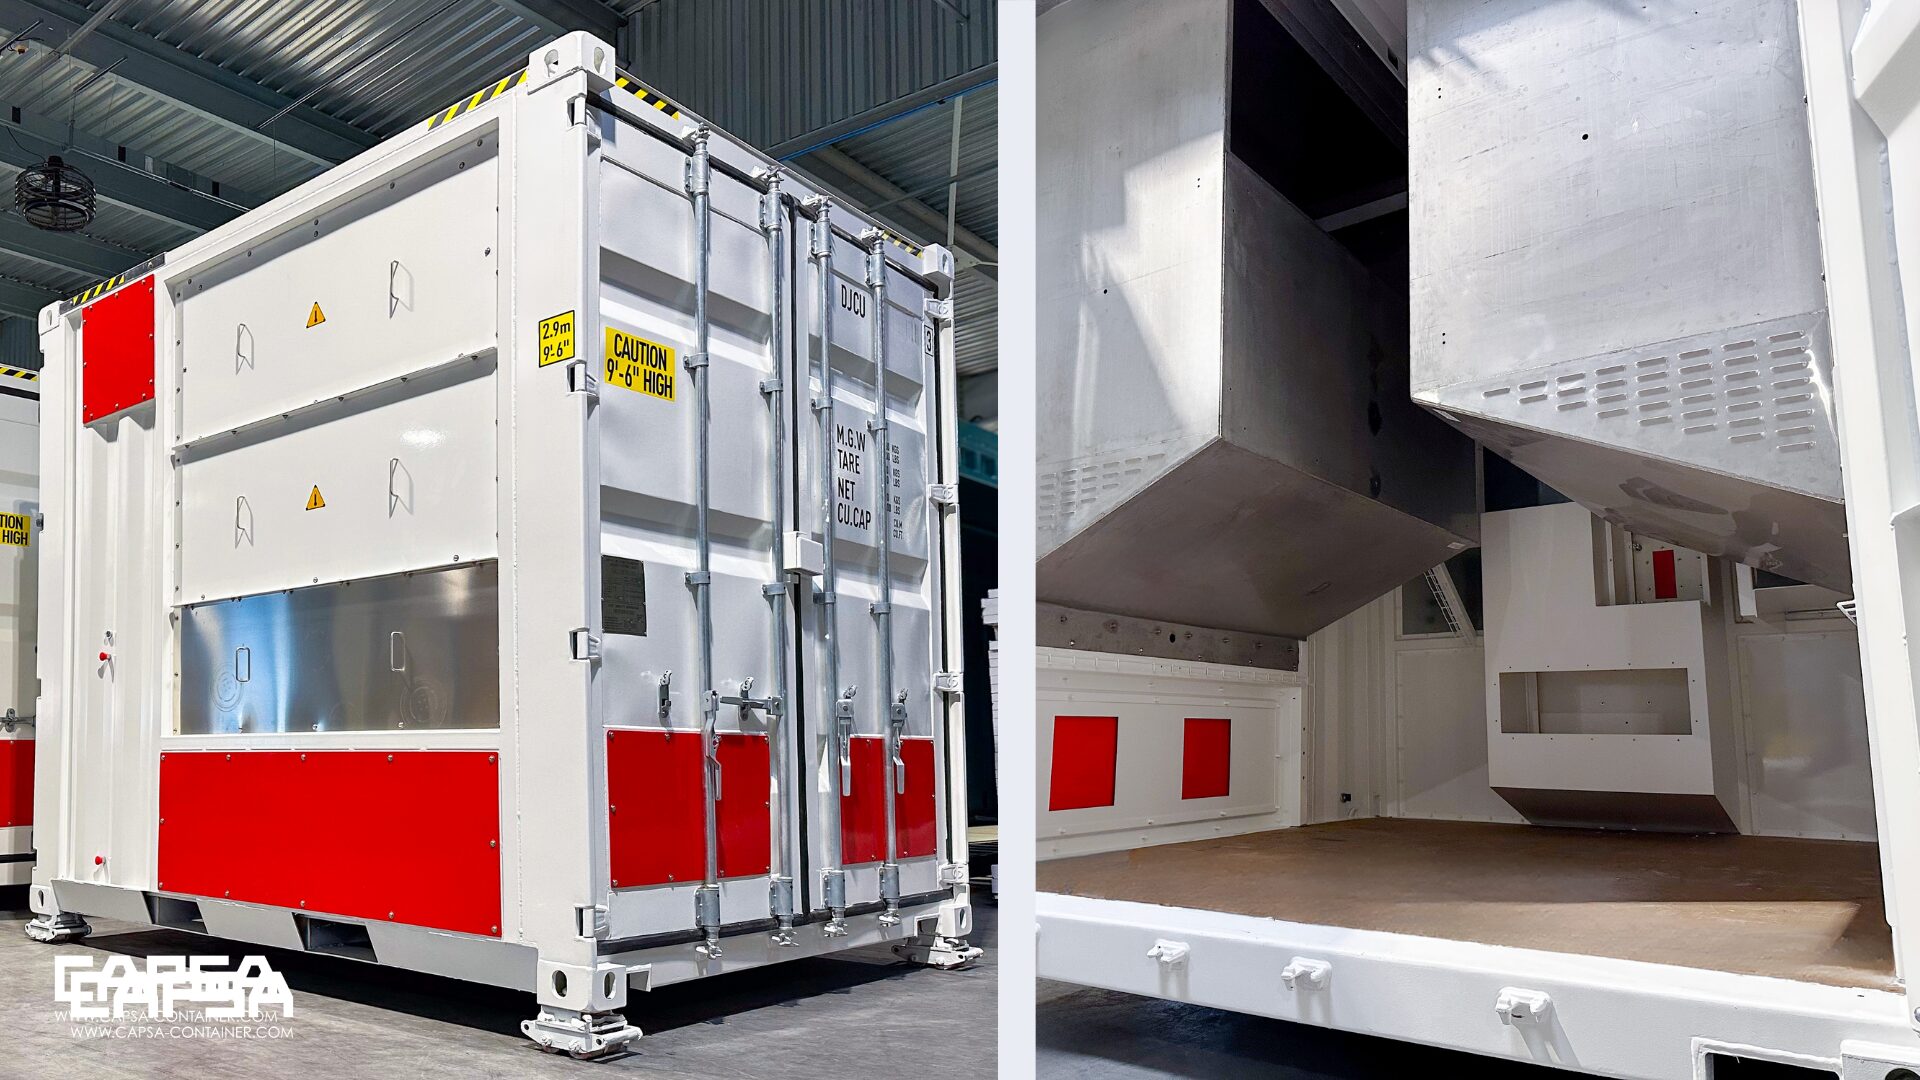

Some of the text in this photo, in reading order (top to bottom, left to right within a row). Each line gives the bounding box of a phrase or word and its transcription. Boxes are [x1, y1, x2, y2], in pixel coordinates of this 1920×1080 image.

[841, 284, 866, 318] DJCU
[542, 321, 571, 340] 2.9m
[543, 339, 570, 361] 9'-6"
[613, 333, 667, 372] CAUTION
[607, 358, 673, 398] 9'-6" HIGH
[836, 424, 866, 452] M.G.W
[837, 449, 860, 474] TARE
[837, 477, 855, 501] NET
[837, 503, 872, 530] CU.CAP
[2, 529, 28, 546] HIGH
